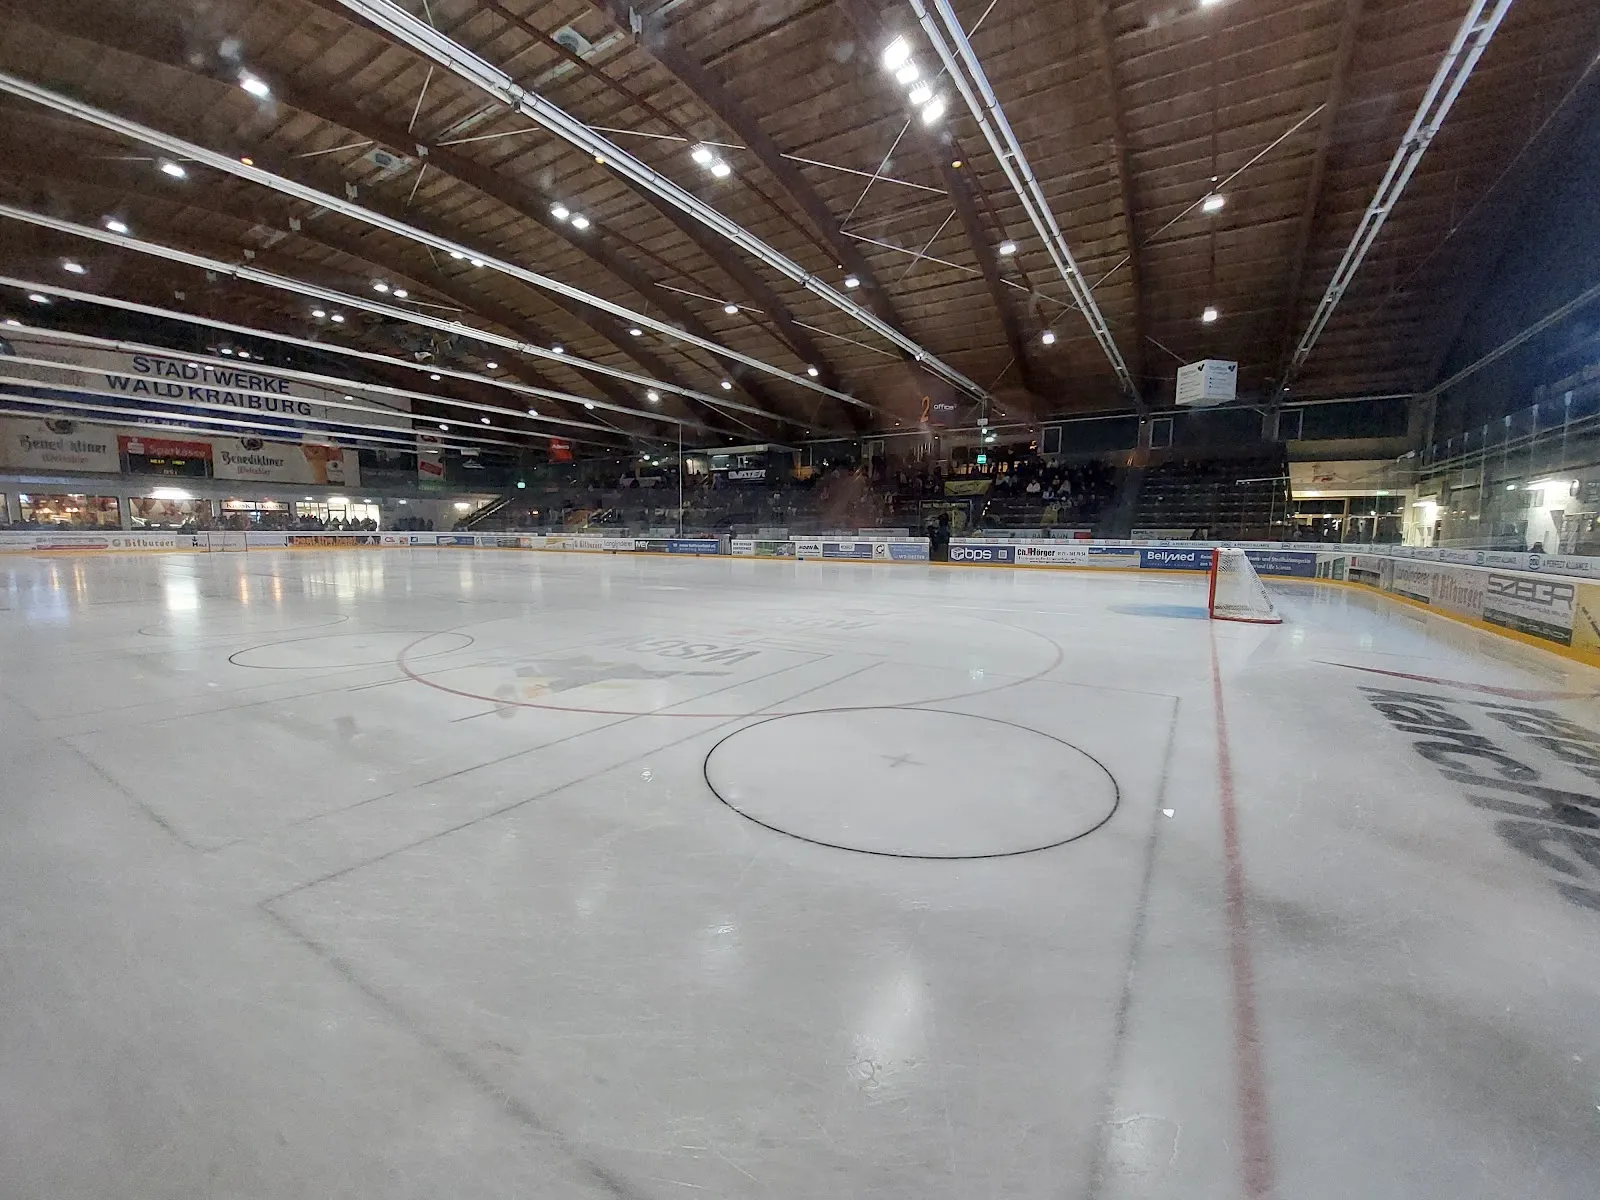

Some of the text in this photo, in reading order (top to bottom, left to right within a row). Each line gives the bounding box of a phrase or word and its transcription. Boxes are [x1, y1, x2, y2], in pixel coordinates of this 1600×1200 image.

[133, 355, 290, 395] STADTWERKE
[105, 374, 312, 416] WALDKRAIBURG
[16, 434, 107, 454] Benedktiner
[220, 450, 285, 467] Benediktiner
[124, 538, 175, 549] Bitburger
[965, 547, 992, 561] bps
